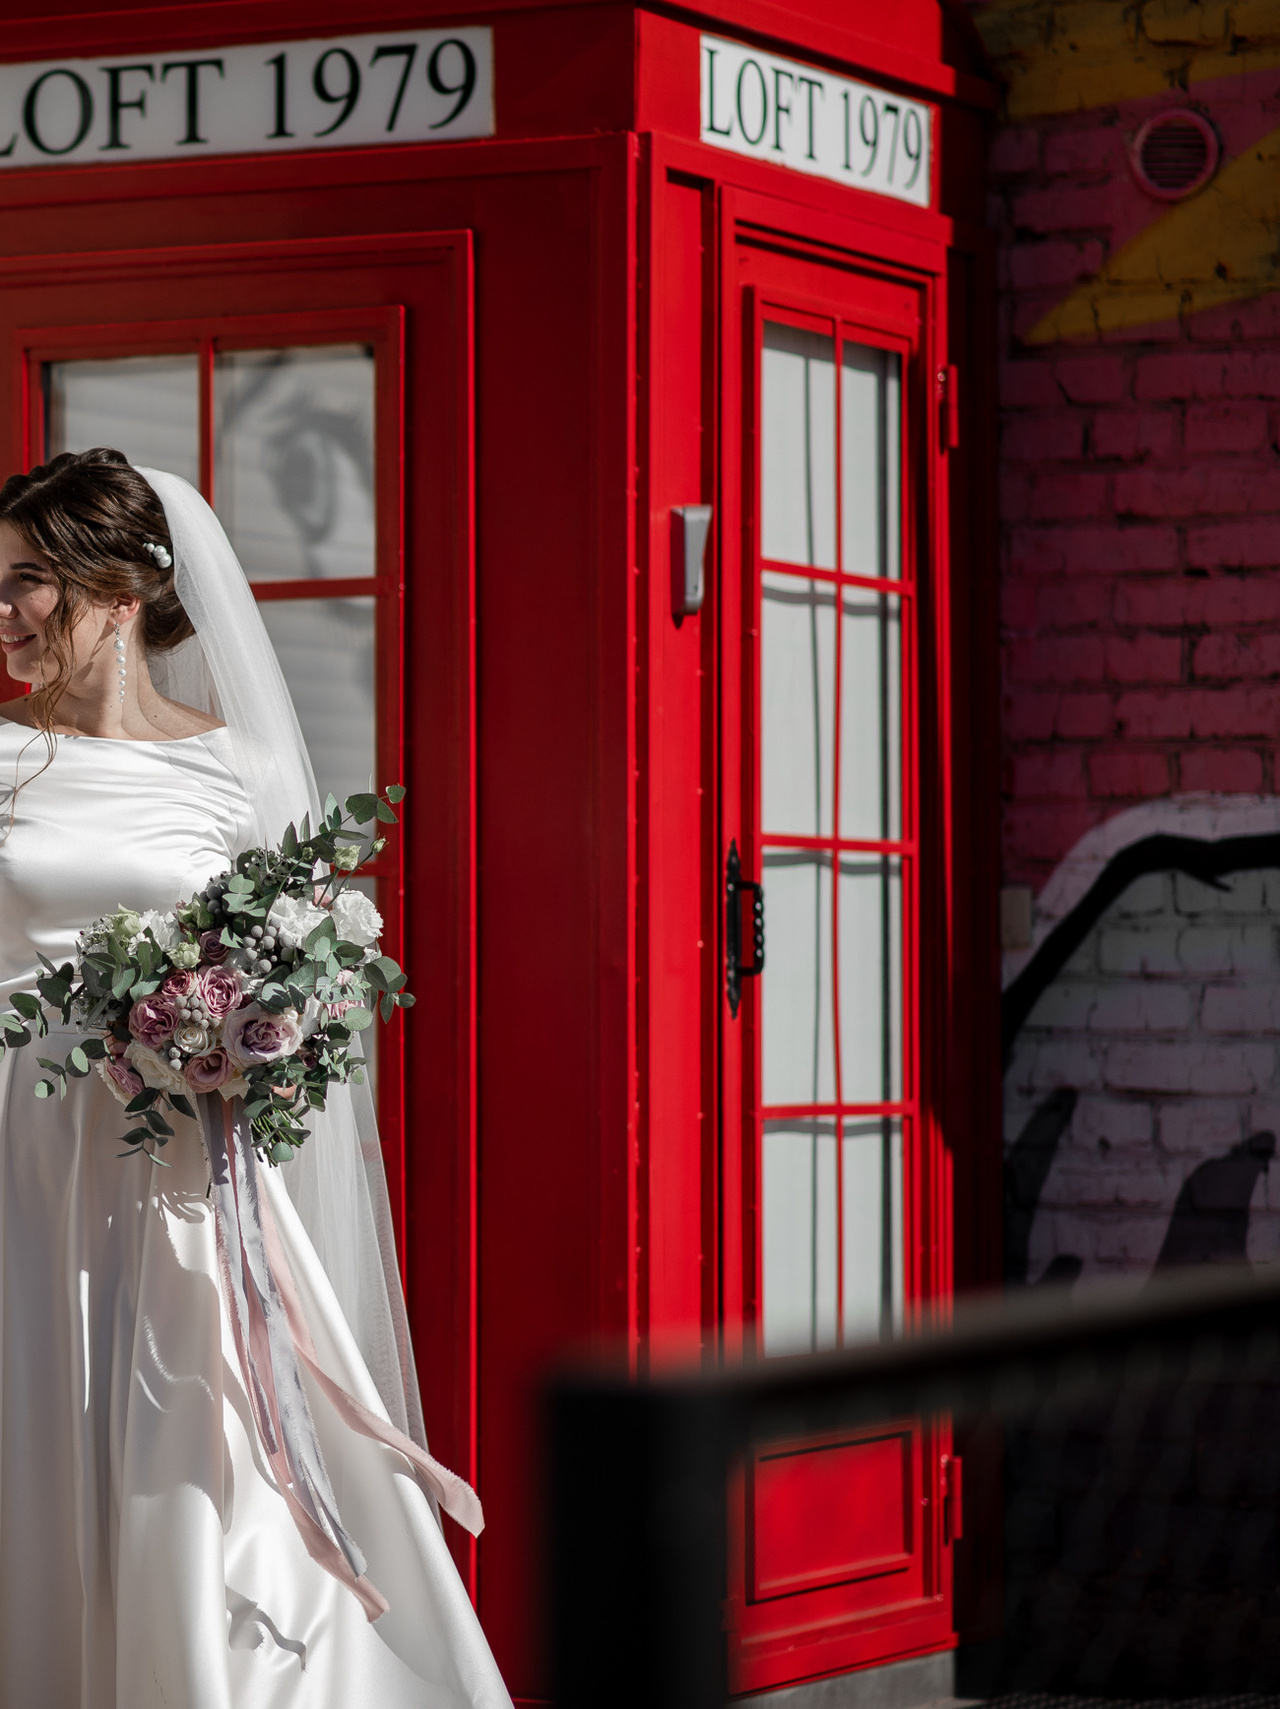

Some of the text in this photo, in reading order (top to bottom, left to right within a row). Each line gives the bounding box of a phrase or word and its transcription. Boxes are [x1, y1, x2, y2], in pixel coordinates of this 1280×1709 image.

[264, 38, 477, 140] 1979
[704, 47, 922, 190] LOFT 1979
